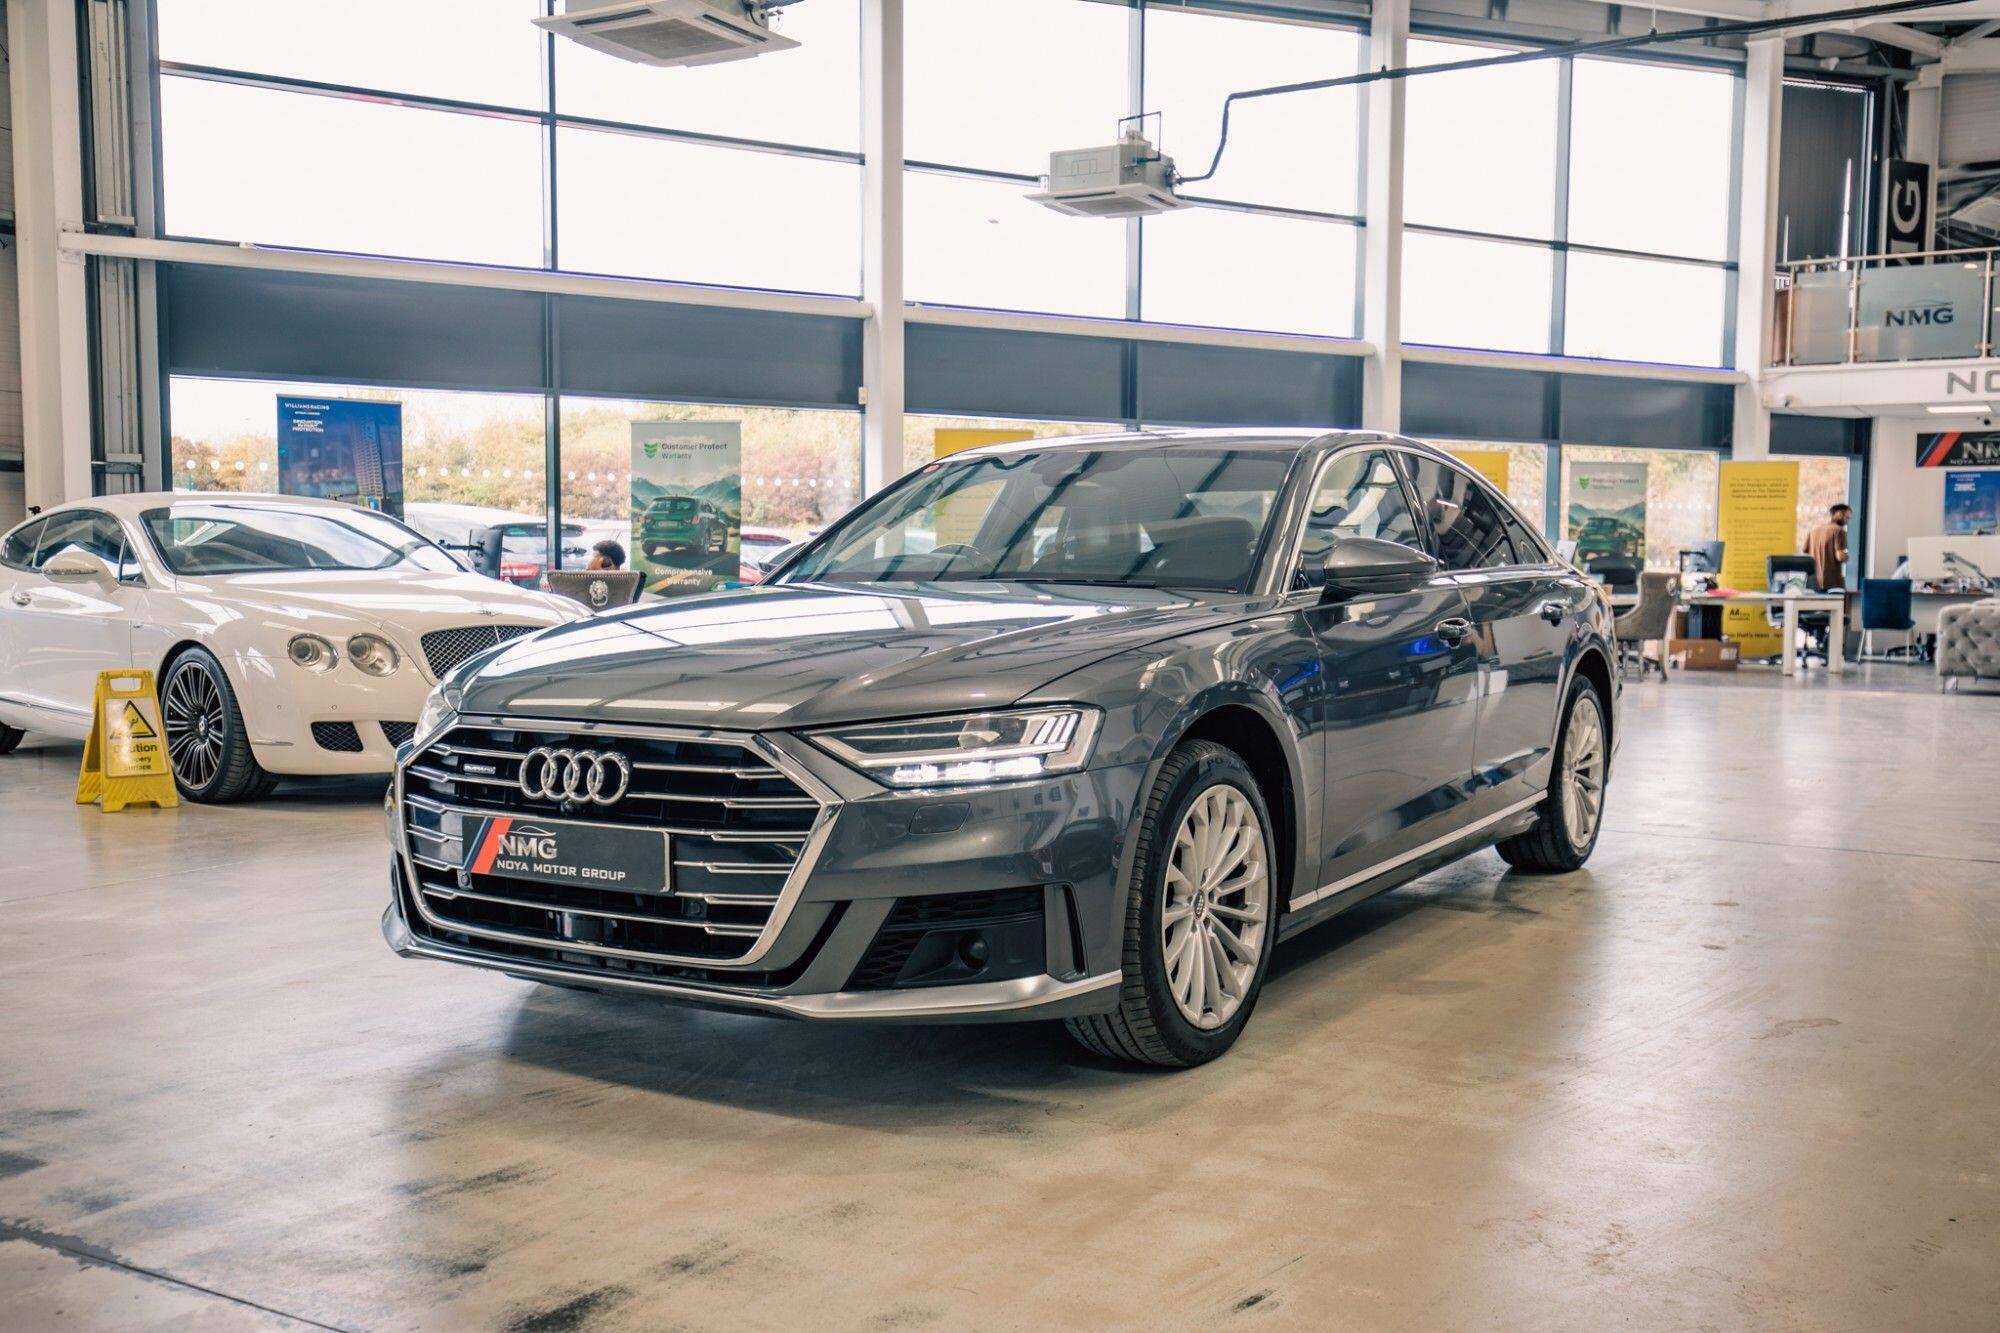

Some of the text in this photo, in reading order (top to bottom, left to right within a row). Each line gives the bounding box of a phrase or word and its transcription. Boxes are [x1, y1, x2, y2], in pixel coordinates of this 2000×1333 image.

[1885, 307, 1954, 327] NMG
[661, 442, 728, 451] Customer Protect
[661, 452, 692, 460] Warranty
[655, 568, 713, 577] Comprehensive
[667, 578, 701, 586] Warranty
[498, 834, 558, 859] NMG
[496, 859, 626, 880] NOYA MOTOR GROUP
